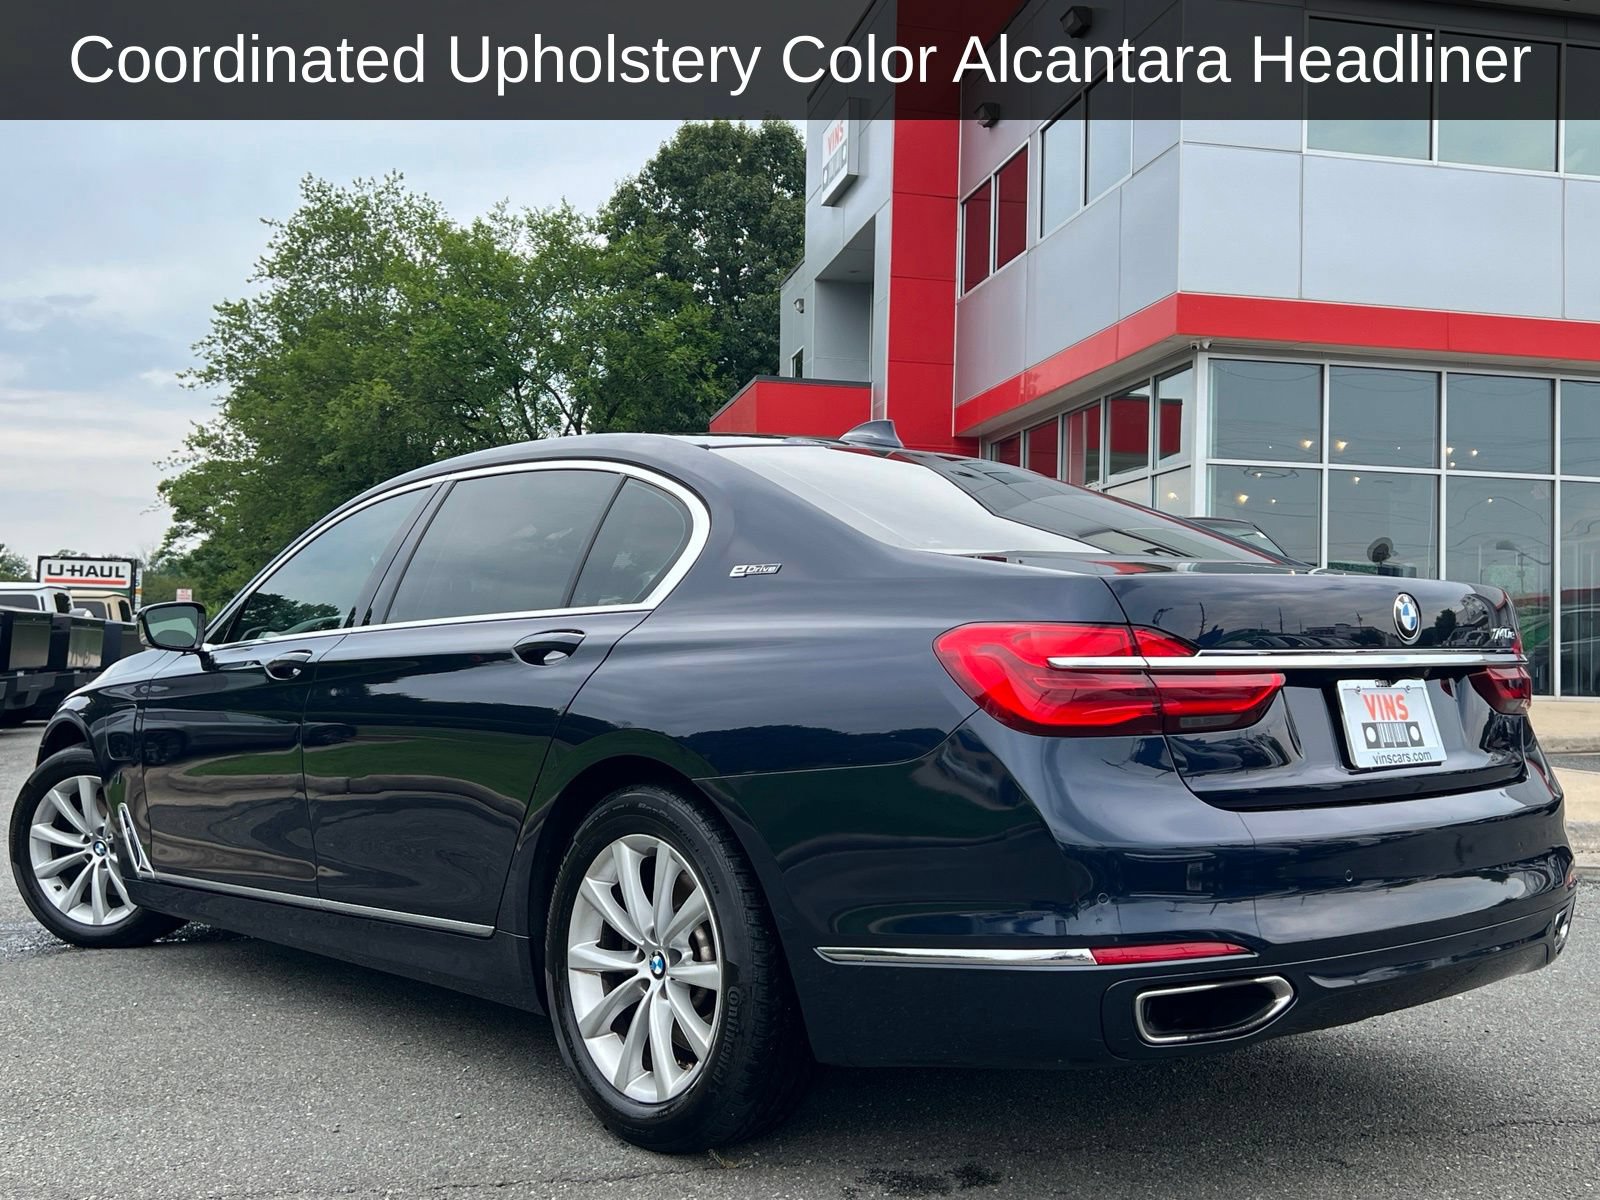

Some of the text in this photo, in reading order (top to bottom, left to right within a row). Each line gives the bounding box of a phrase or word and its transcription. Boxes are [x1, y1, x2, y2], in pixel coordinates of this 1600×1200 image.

[47, 563, 126, 579] U-HAUL
[729, 563, 781, 577] eDrive
[1362, 693, 1410, 721] VINS
[1372, 751, 1433, 765] vinscars.com
[711, 985, 742, 1087] Continental
